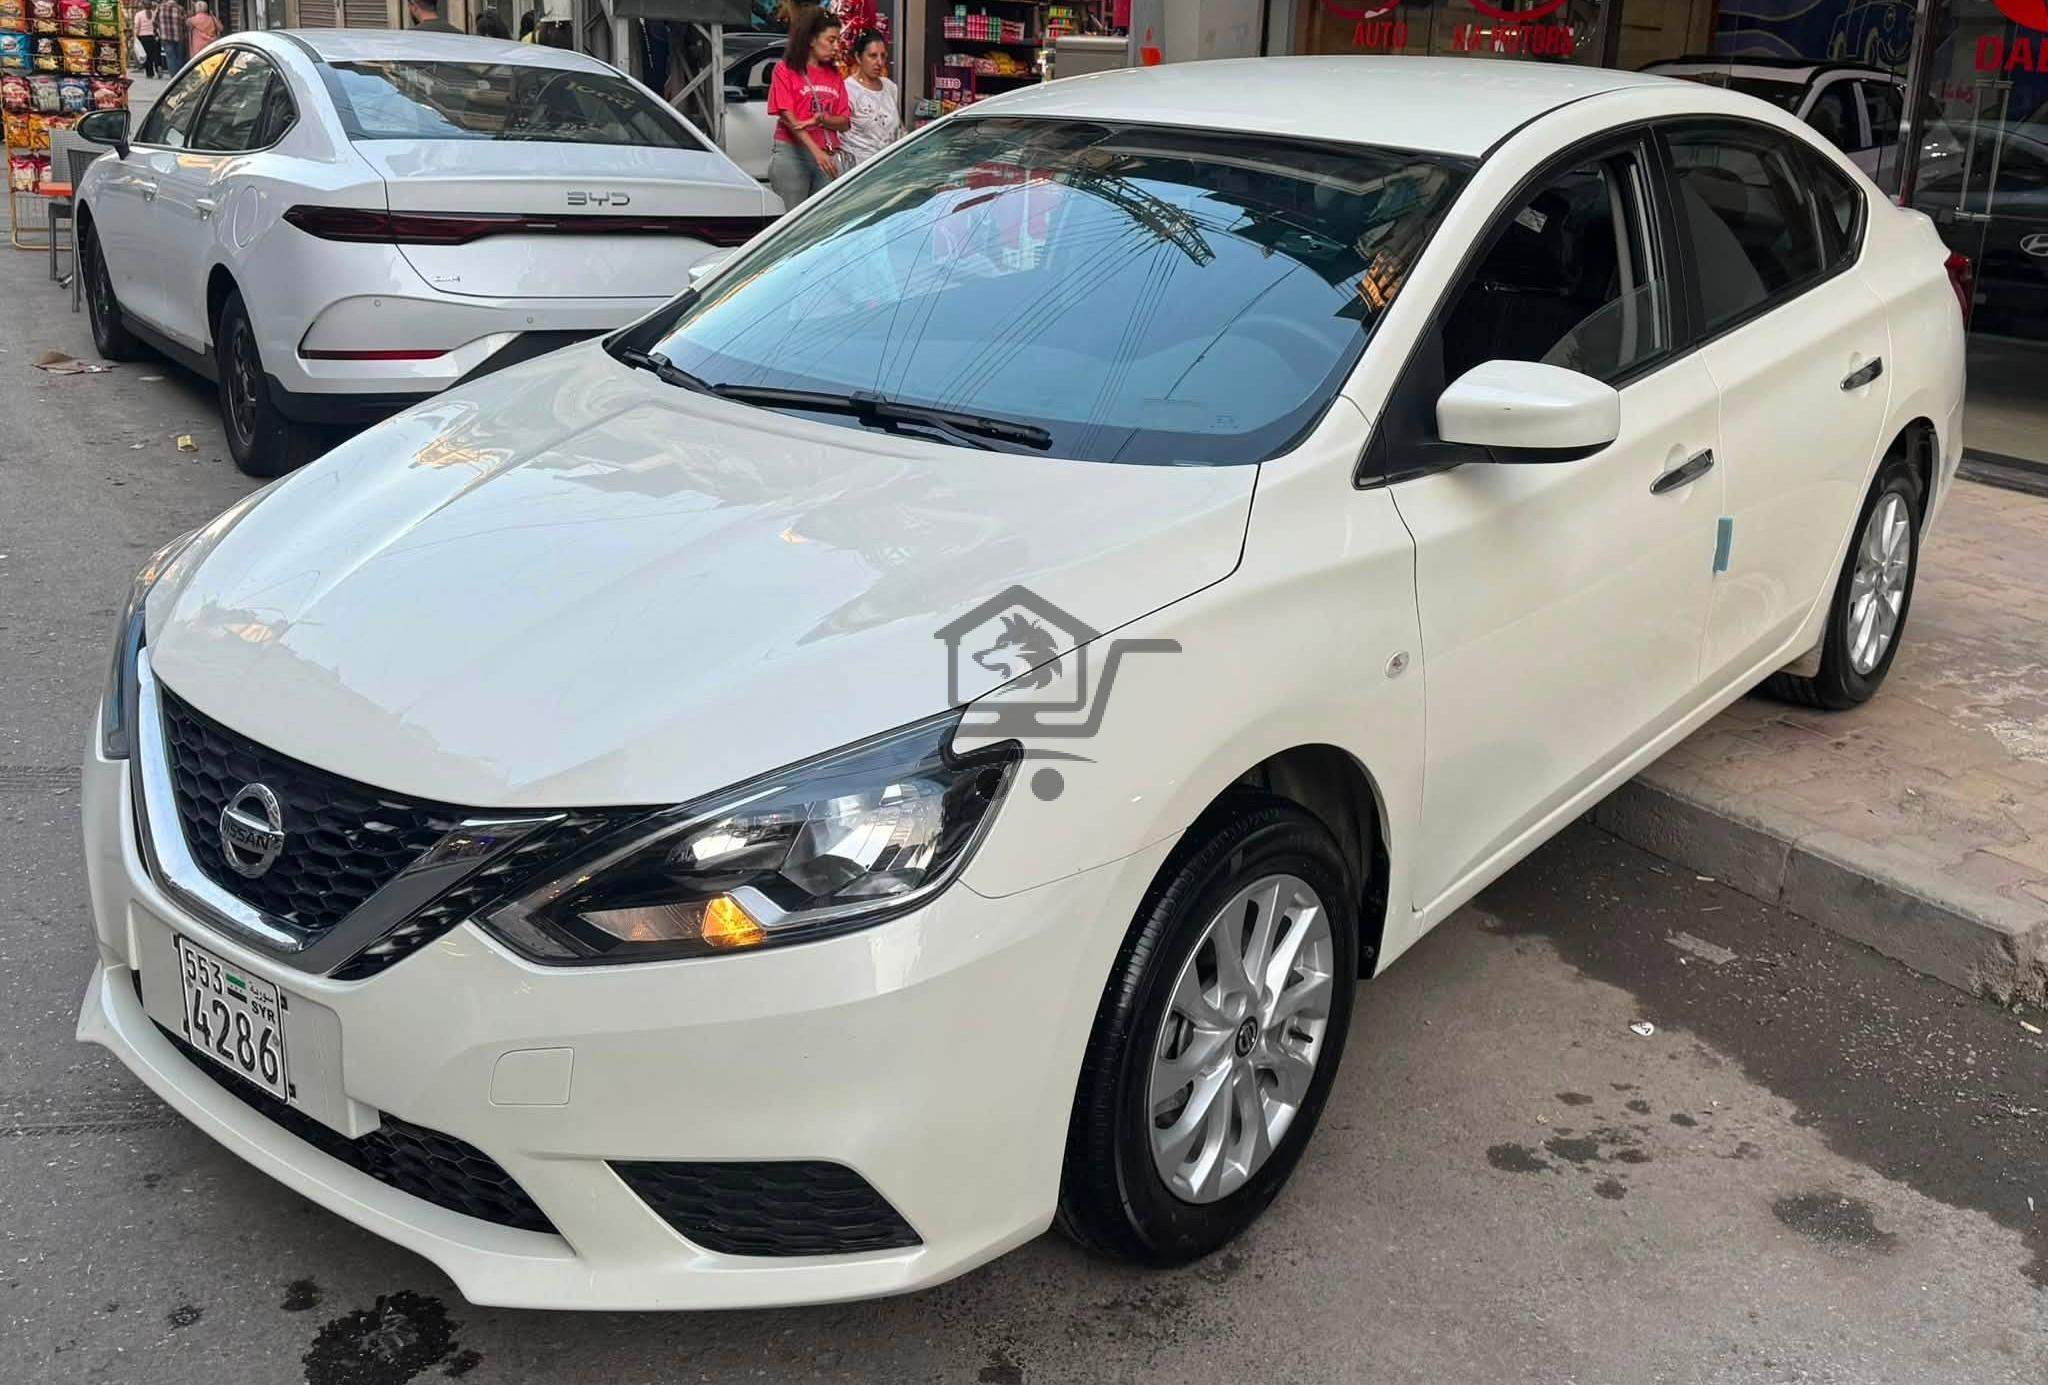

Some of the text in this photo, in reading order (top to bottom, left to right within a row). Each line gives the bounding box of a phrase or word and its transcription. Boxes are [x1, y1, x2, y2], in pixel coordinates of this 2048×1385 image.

[1352, 22, 1408, 48] AUTO
[1488, 26, 1575, 55] MOTORS
[567, 191, 630, 206] BYD
[224, 815, 271, 850] NISSAN
[185, 948, 223, 995] 553
[251, 1000, 276, 1024] SYR
[193, 988, 279, 1085] 4286
